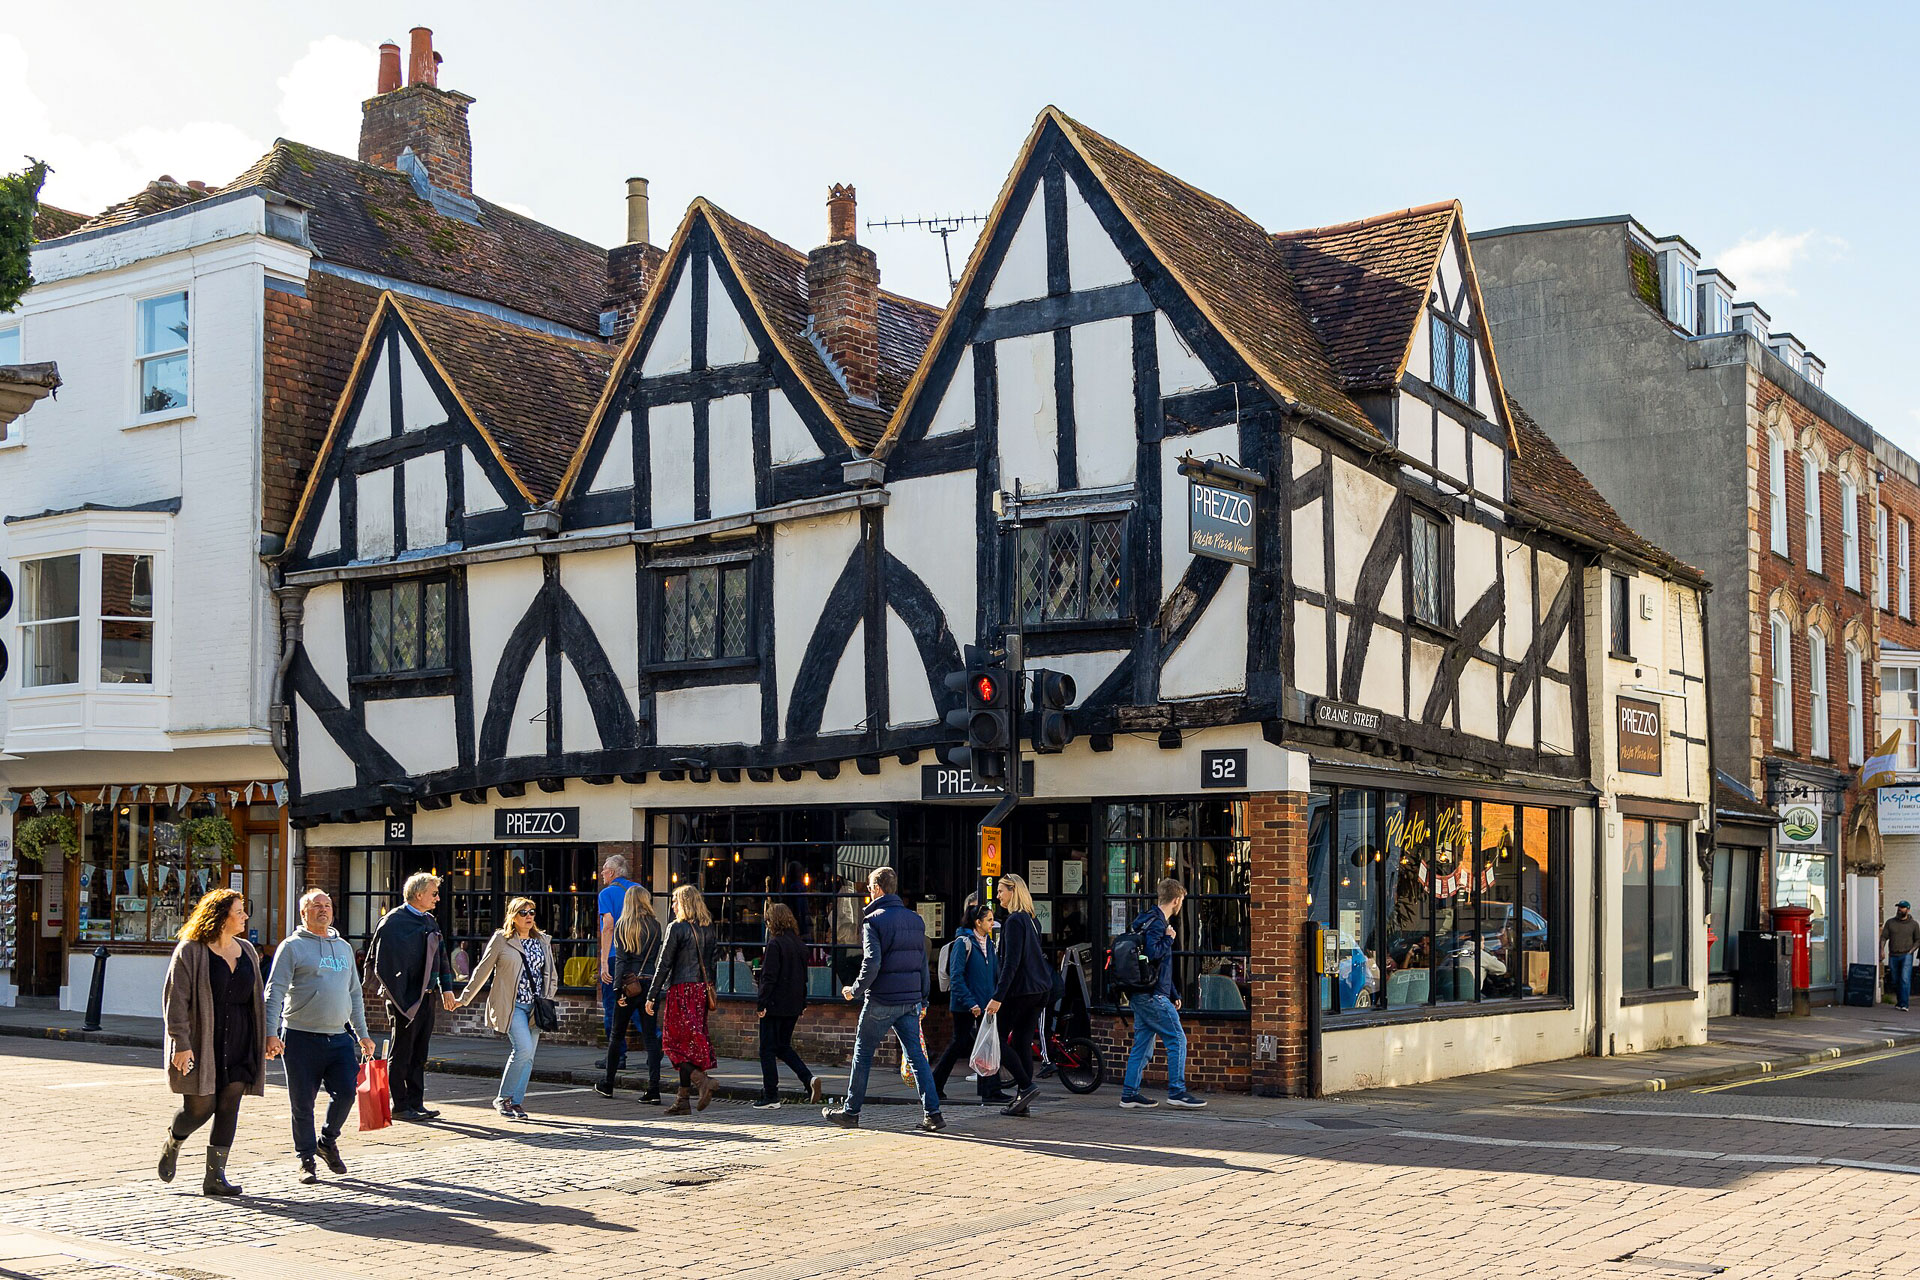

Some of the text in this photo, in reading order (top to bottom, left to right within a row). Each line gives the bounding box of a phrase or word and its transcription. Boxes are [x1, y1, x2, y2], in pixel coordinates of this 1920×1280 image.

[1194, 485, 1252, 527] PREZZO
[1193, 530, 1214, 547] Pasta
[1213, 532, 1233, 552] Pizza
[1320, 706, 1378, 729] CRANE STREET
[1621, 707, 1658, 737] PREZZO
[1211, 758, 1236, 779] 52
[937, 768, 1005, 794] PRE
[390, 822, 406, 839] 52
[506, 812, 566, 834] PREZZO
[1386, 809, 1426, 853] Pasta
